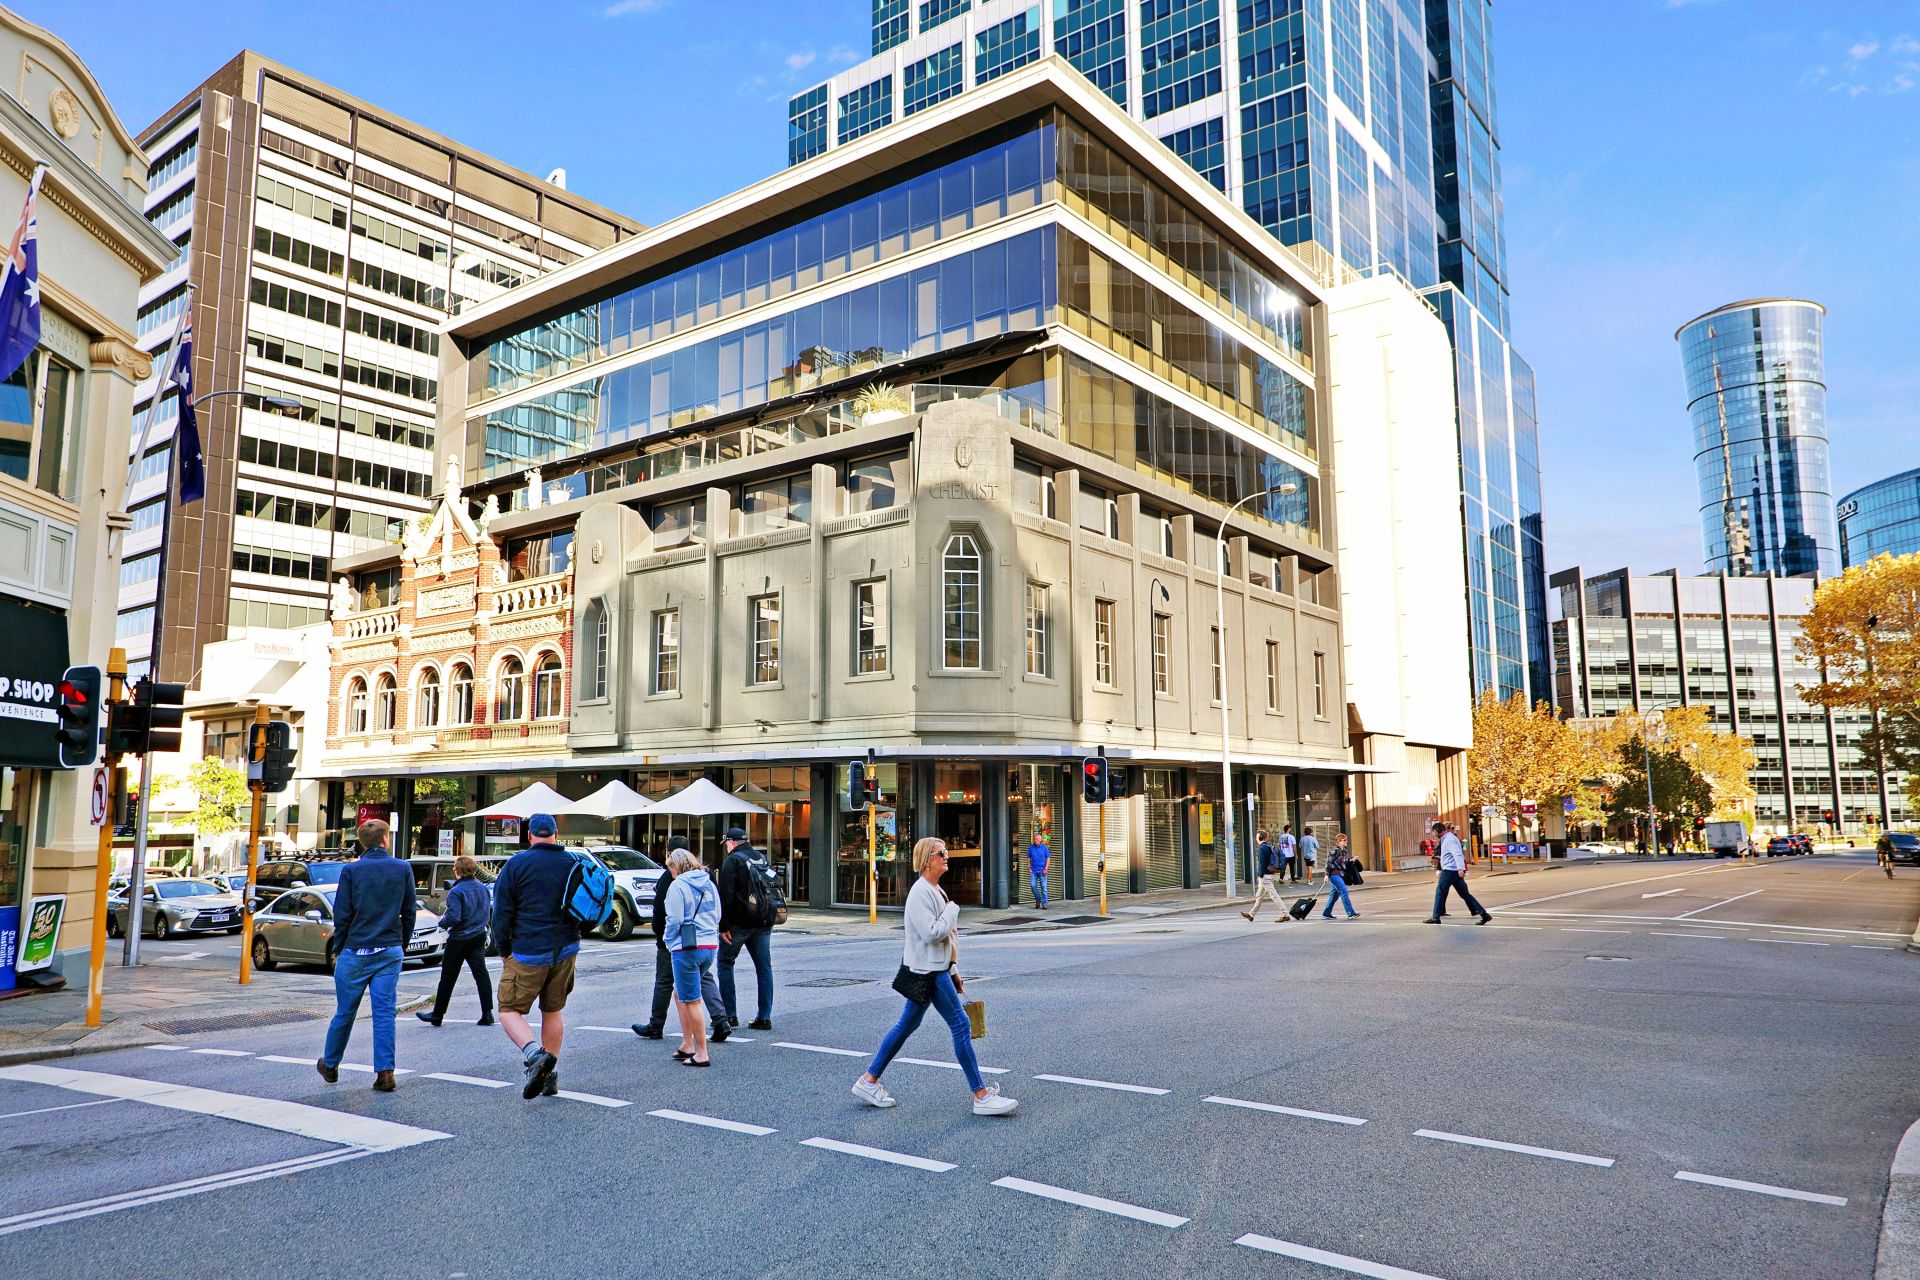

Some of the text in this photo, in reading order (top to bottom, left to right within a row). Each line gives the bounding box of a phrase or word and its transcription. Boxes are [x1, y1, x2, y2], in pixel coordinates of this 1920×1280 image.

[929, 482, 998, 501] CHEMIST
[0, 677, 54, 703] P.SHOP
[0, 929, 8, 968] Australian
[7, 930, 16, 966] The West
